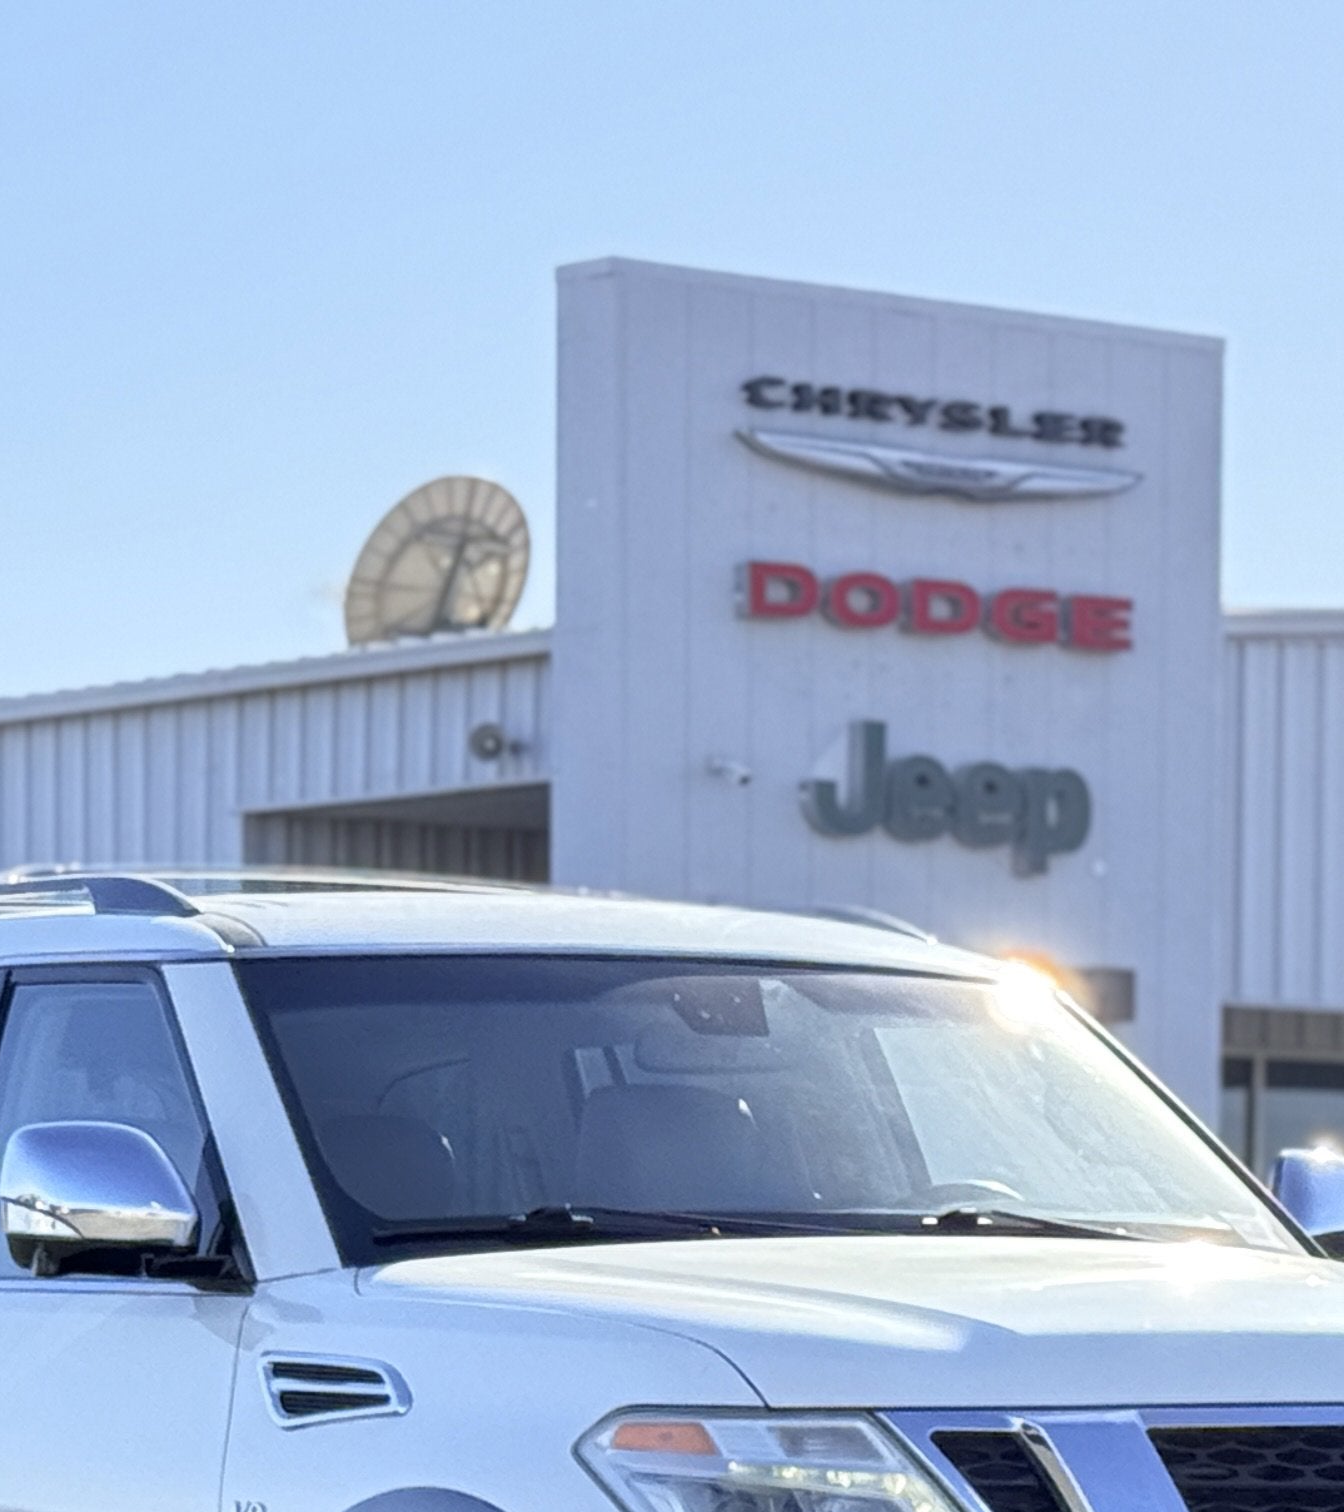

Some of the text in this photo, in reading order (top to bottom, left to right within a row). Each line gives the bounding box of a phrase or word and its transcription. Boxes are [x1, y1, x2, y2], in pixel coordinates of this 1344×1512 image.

[740, 375, 1125, 450] CHRYSLER
[738, 560, 1134, 652] DODGE
[800, 720, 1091, 878] Jeep
